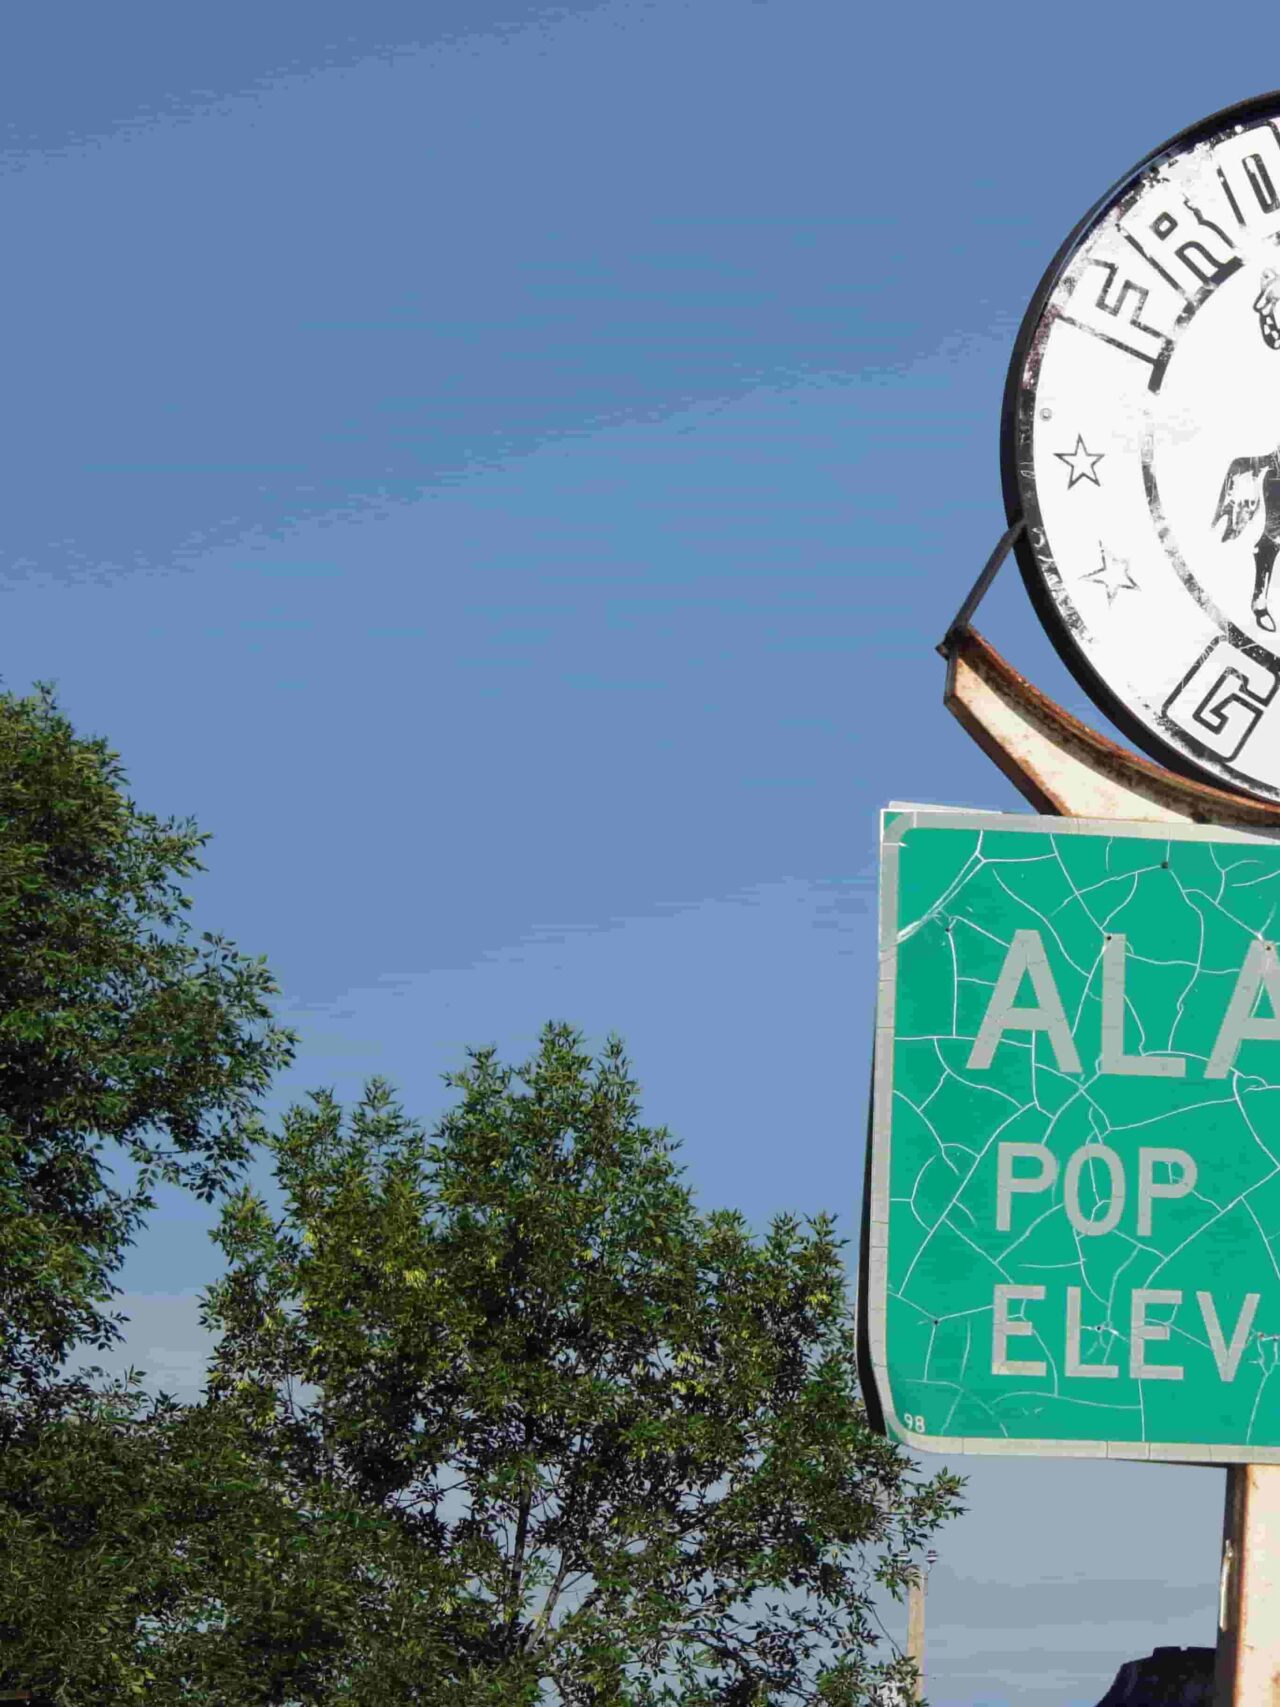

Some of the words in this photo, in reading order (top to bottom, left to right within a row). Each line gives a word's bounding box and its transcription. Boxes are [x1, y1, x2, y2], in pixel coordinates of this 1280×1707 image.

[994, 1141, 1199, 1237] POP
[991, 1284, 1261, 1383] ELEV
[903, 1412, 926, 1434] 98
